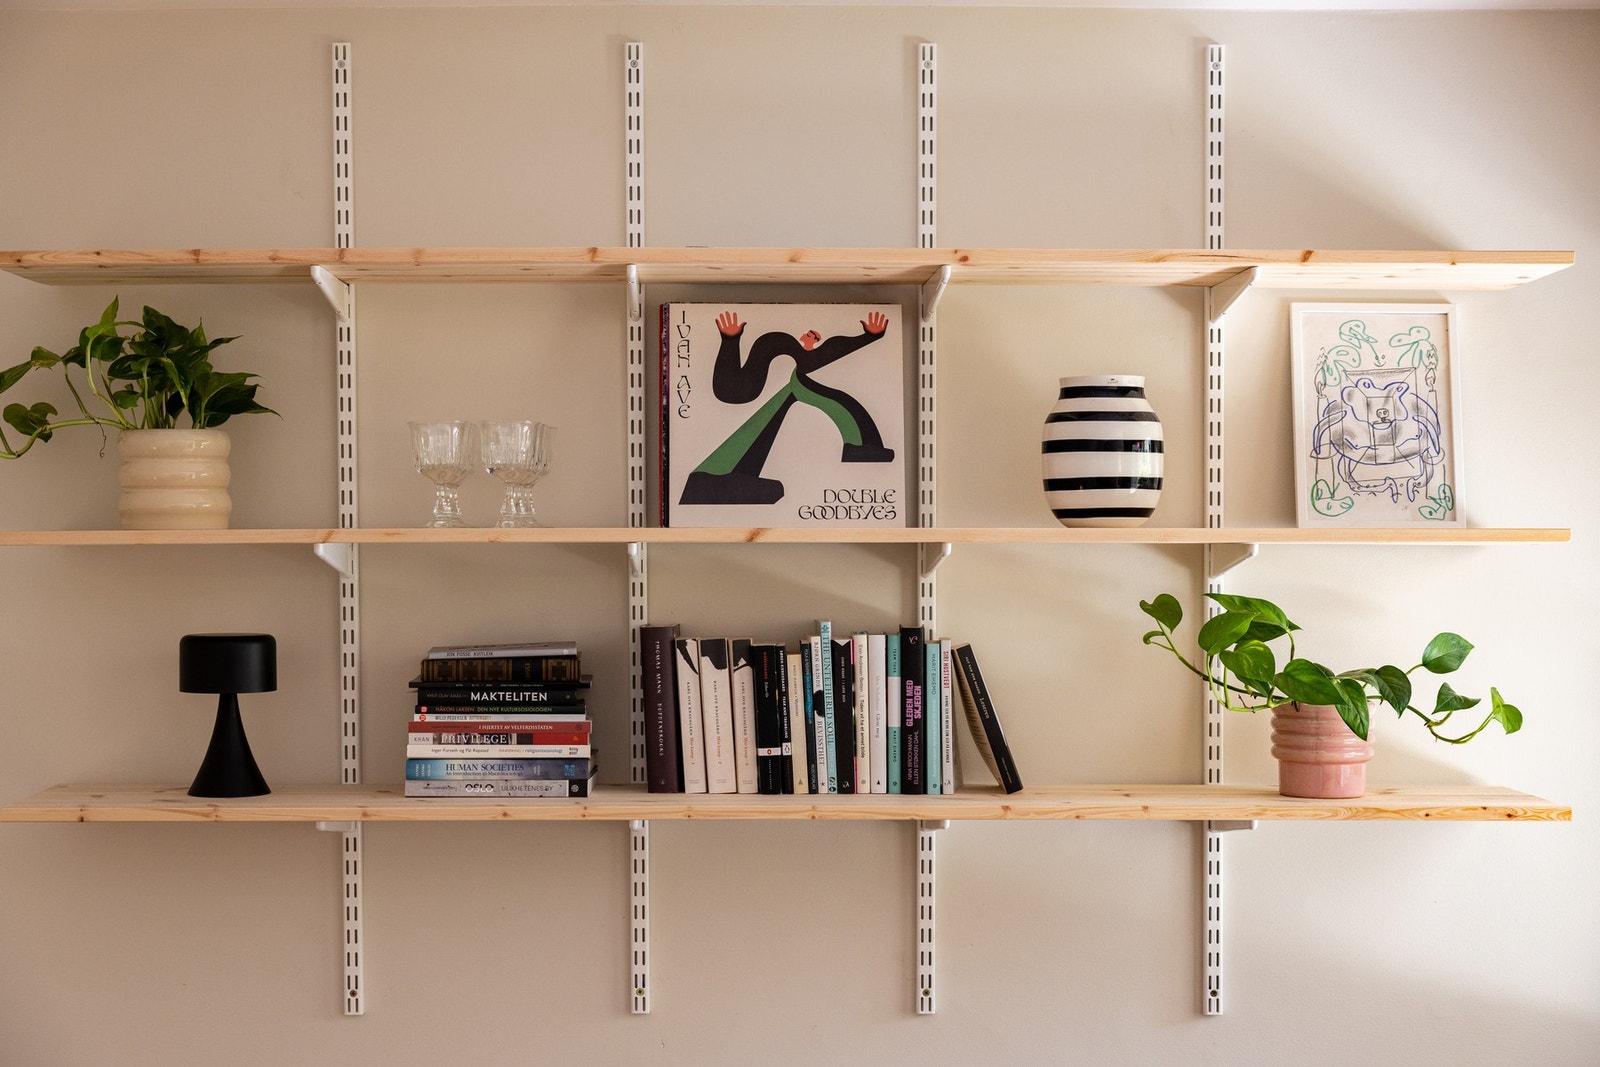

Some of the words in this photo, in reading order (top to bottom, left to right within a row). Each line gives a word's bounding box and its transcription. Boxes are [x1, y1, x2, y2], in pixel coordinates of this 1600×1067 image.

[676, 310, 691, 368] IVAN
[676, 376, 691, 418] AVE
[824, 489, 896, 504] DOUBLE
[798, 506, 897, 520] GOODBYES
[823, 656, 832, 719] UNTETHERED
[471, 692, 548, 701] MAKTELITEN
[979, 697, 990, 720] Leseren
[441, 734, 507, 744] PRIVILEGE
[446, 764, 478, 772] HUMAN
[481, 764, 524, 772] SOCIETIES
[465, 784, 494, 792] OSLO
